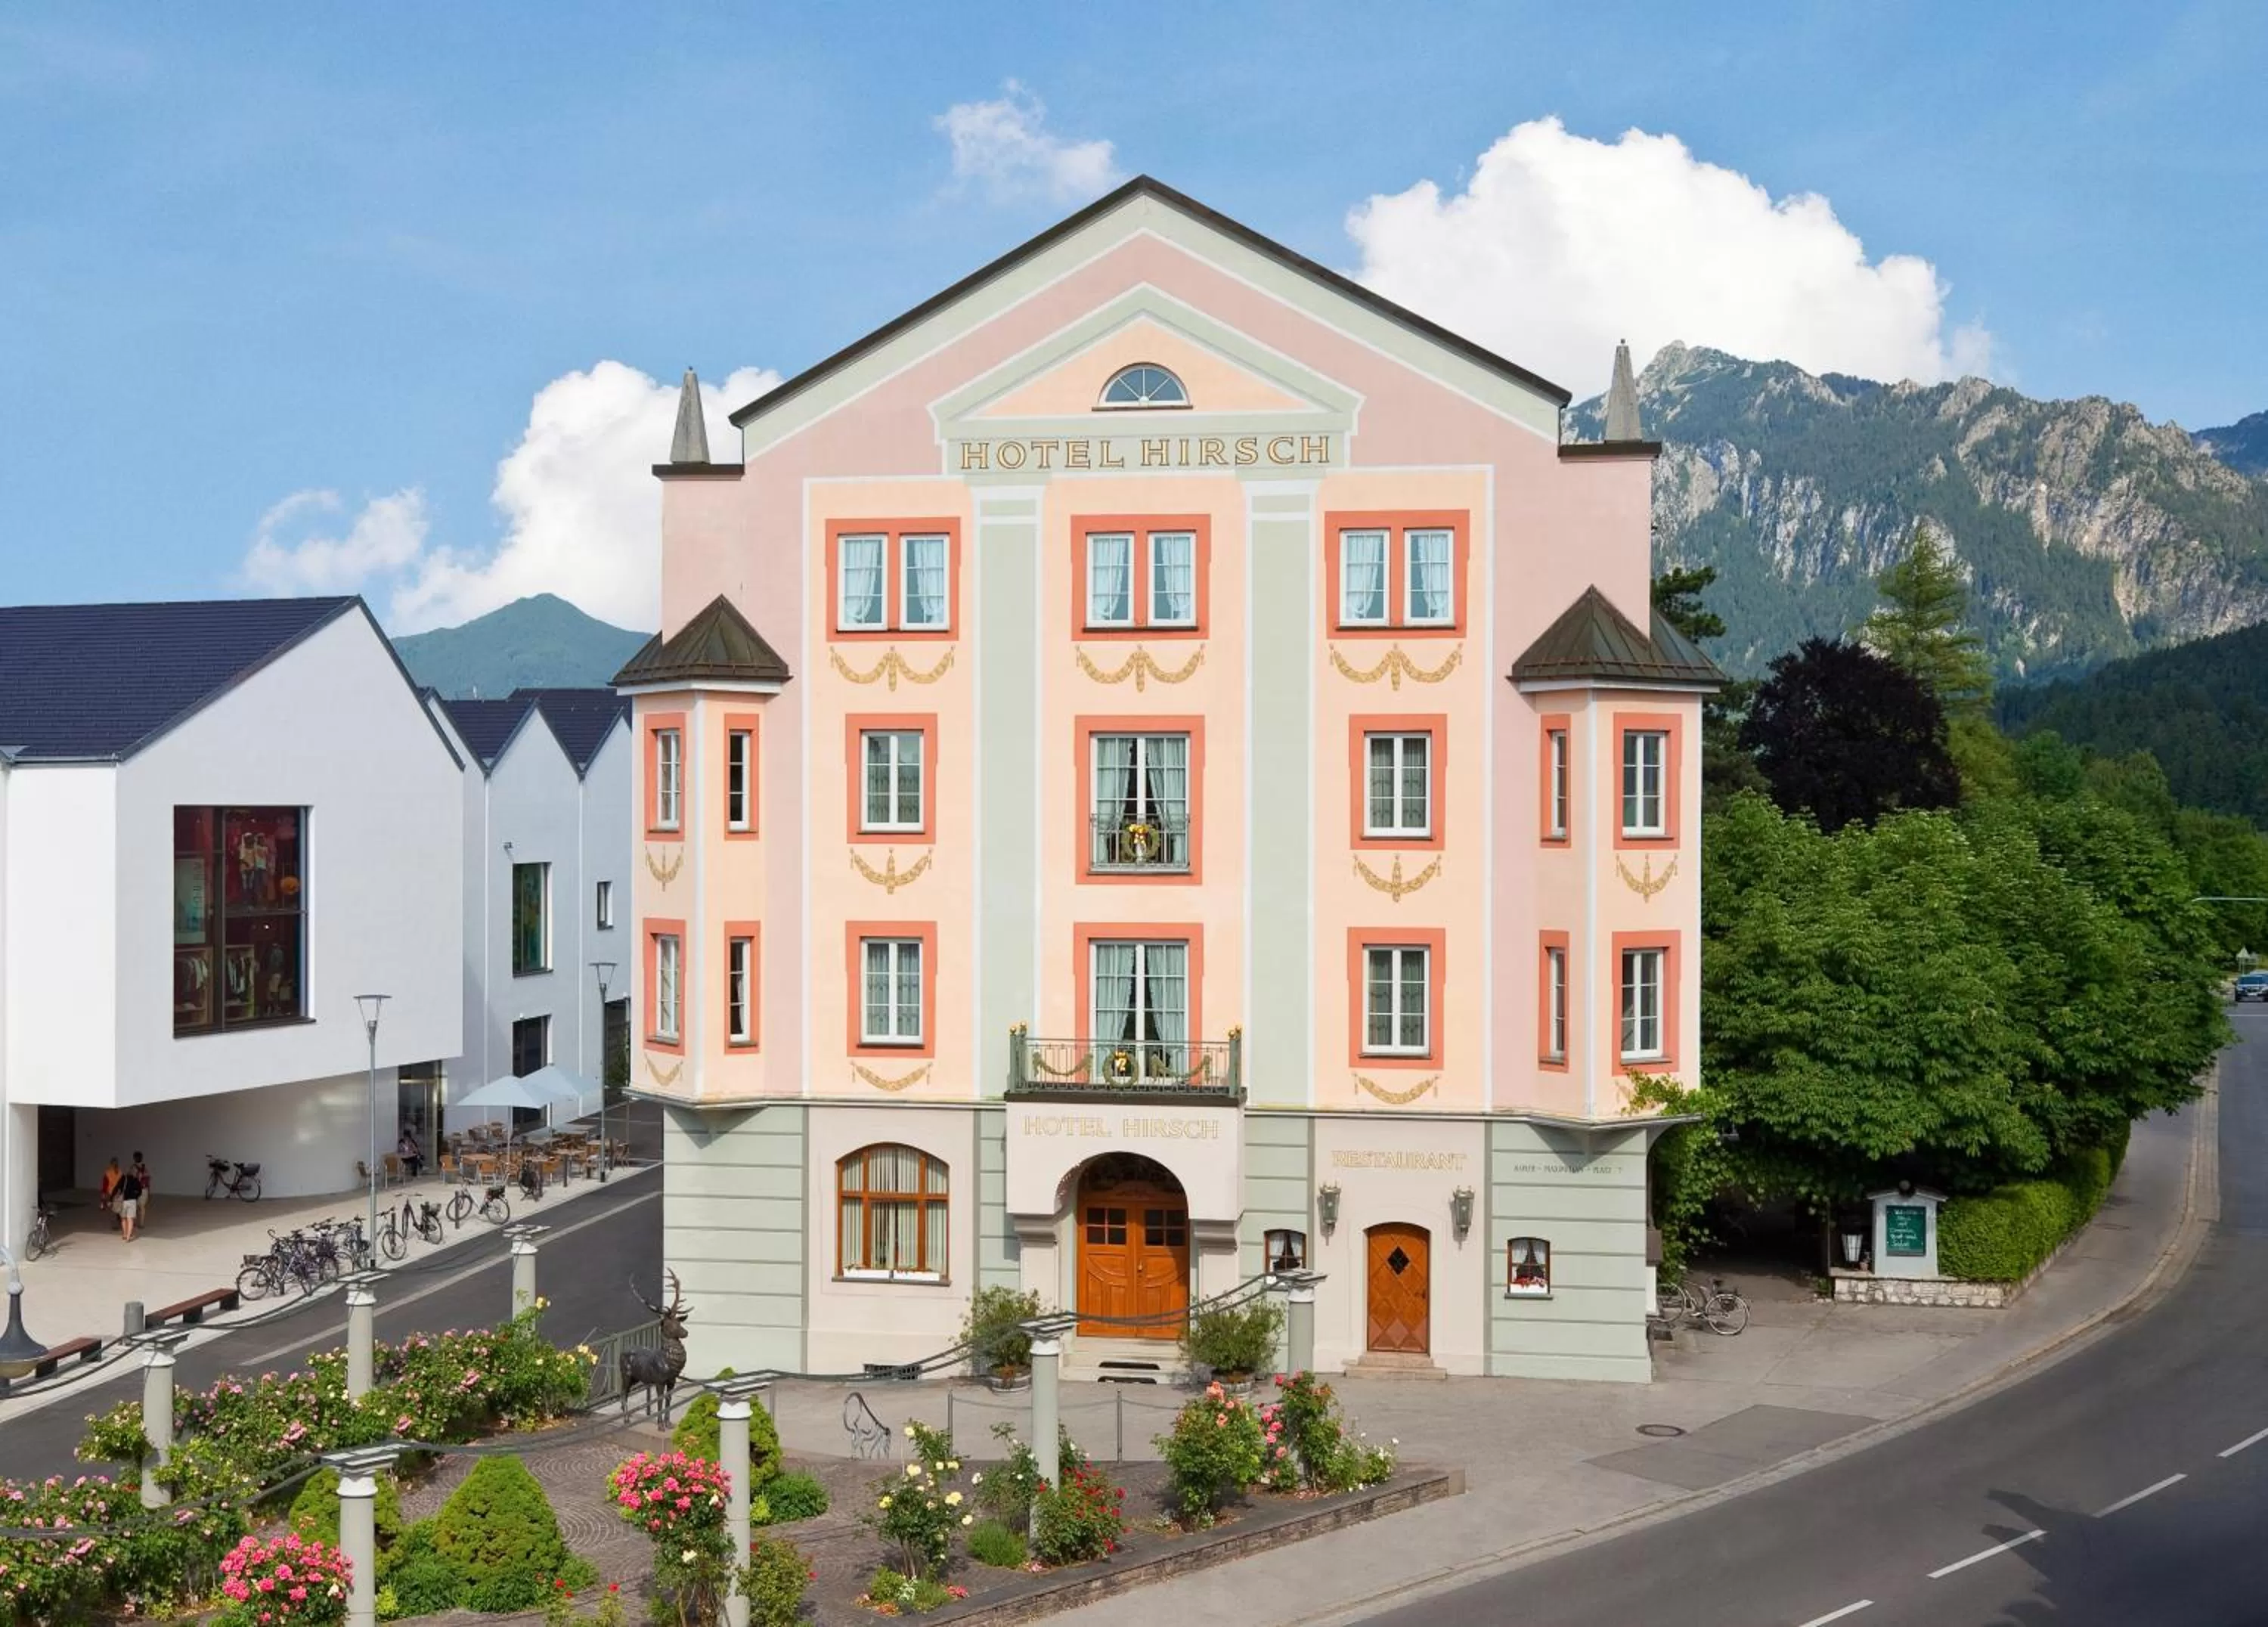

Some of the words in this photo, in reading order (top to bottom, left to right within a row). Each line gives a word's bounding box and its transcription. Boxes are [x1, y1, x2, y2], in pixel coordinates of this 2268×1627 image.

[960, 439, 1125, 470] HOTEL
[1140, 435, 1331, 468] HIRSCH
[1024, 1114, 1112, 1137] HOTEL
[1123, 1117, 1220, 1139] HIRSCH
[1330, 1149, 1467, 1171] RESTAURANT
